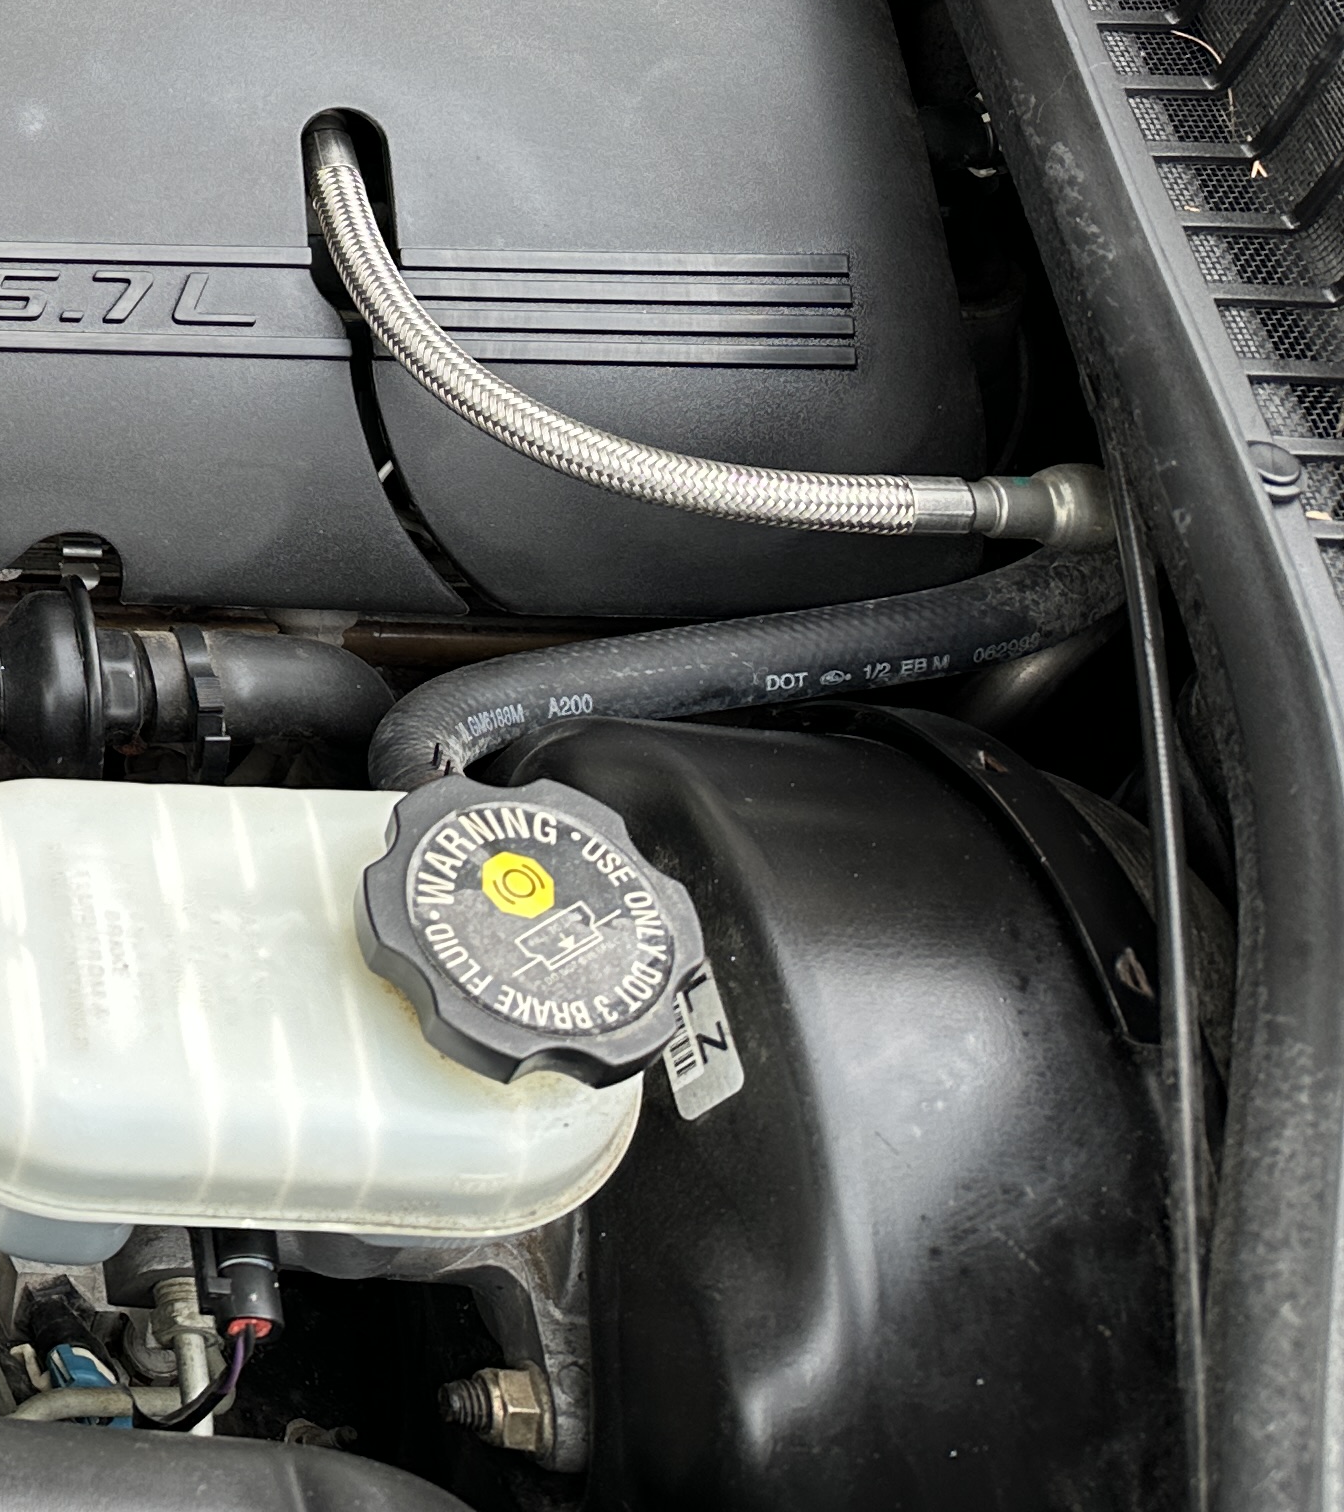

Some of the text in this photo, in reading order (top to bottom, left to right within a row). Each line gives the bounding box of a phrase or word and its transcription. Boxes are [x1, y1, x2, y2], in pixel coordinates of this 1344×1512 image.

[547, 693, 594, 719] A200
[765, 671, 809, 692] DOT
[863, 661, 892, 680] 1/2
[416, 807, 558, 905] WARNING
[581, 836, 637, 887] USE
[623, 890, 668, 961] ONLY
[424, 922, 494, 996] FLUID
[492, 984, 594, 1030] BRAKE
[593, 994, 619, 1022] 3
[613, 961, 664, 1014] DOT
